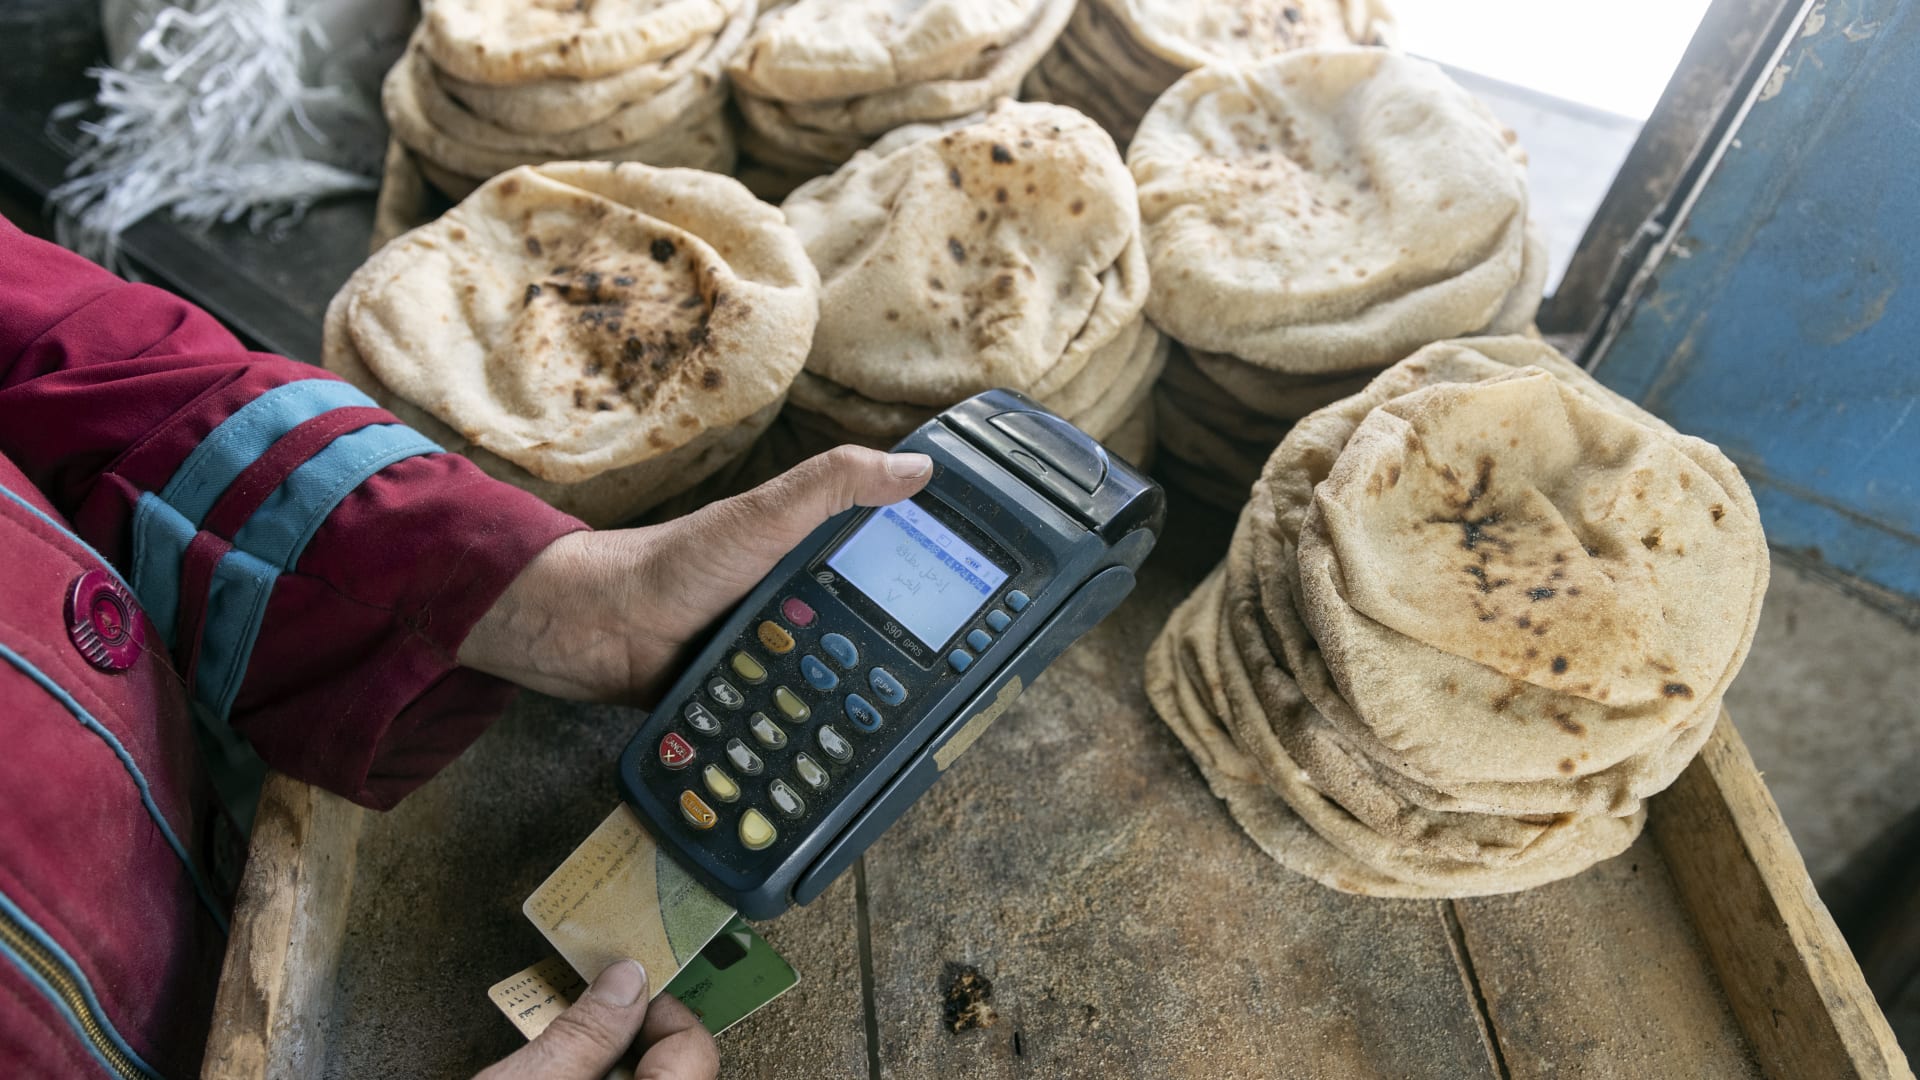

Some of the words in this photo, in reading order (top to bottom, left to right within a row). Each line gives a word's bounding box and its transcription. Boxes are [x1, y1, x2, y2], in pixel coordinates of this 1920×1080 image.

[883, 622, 903, 639] S90
[903, 639, 923, 657] GPRS
[665, 736, 689, 758] CANCEL
